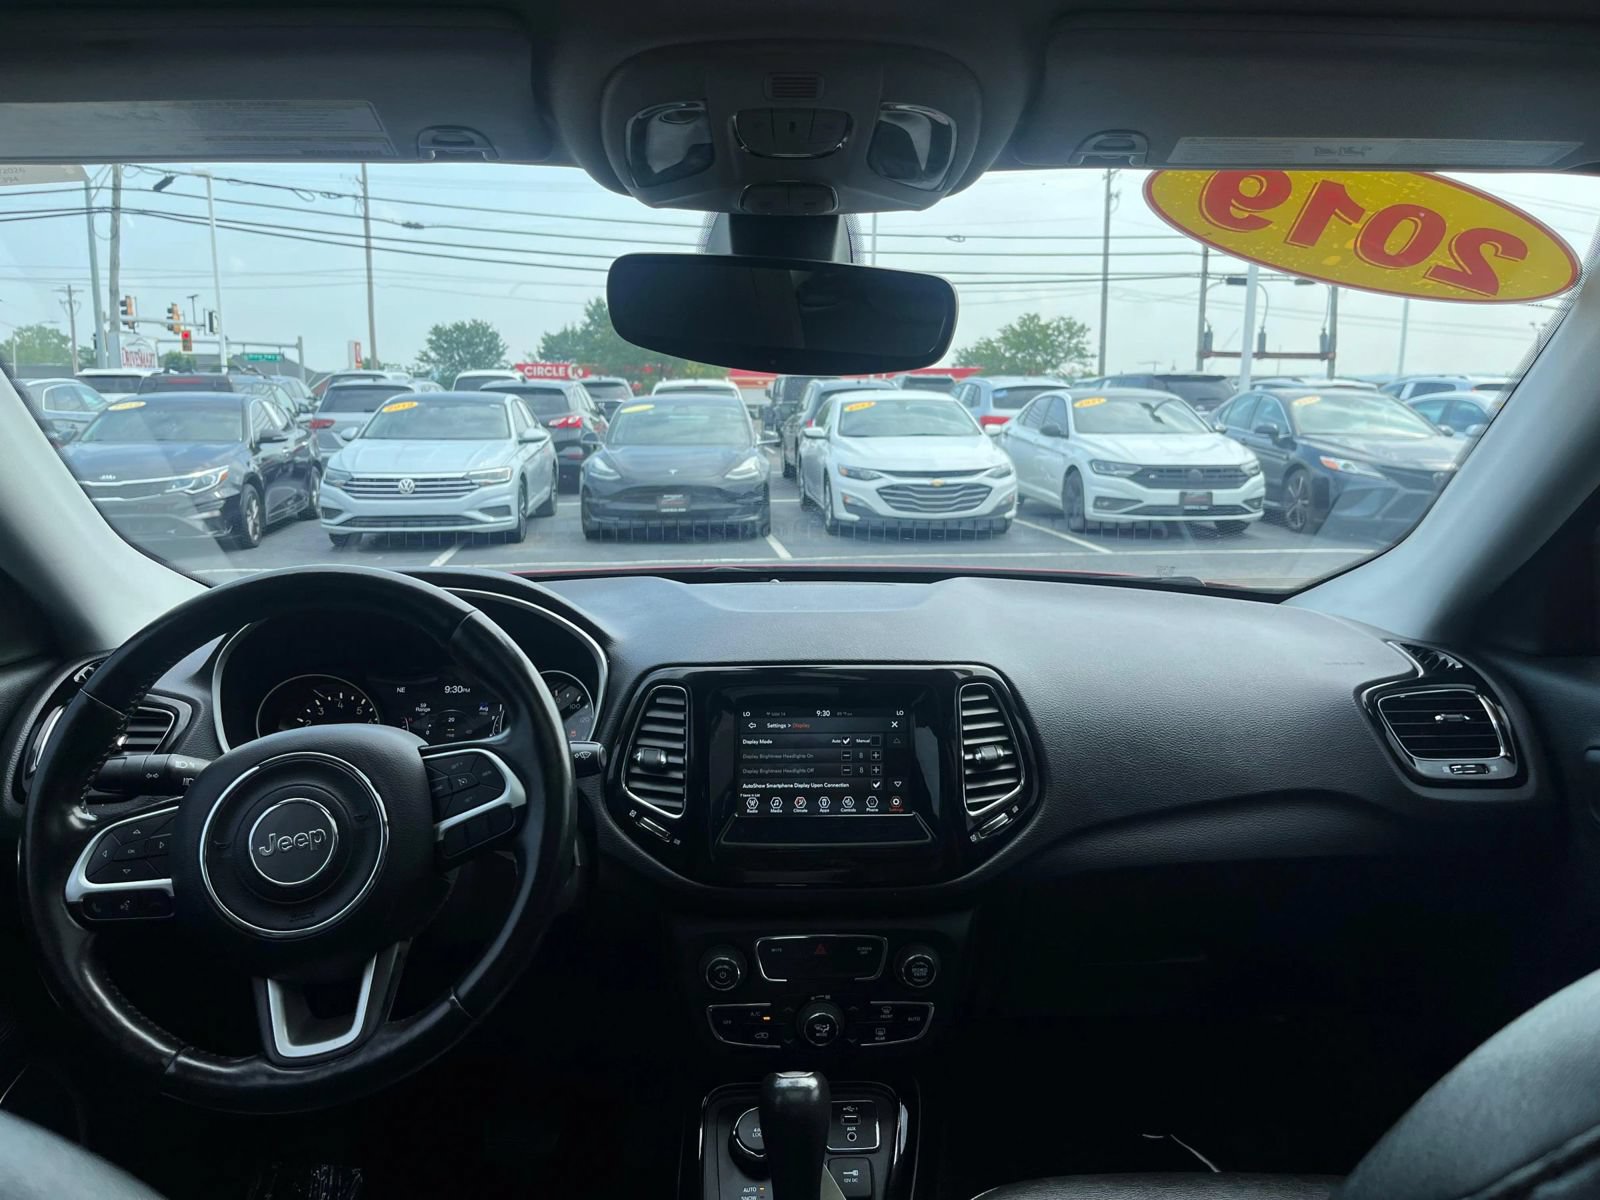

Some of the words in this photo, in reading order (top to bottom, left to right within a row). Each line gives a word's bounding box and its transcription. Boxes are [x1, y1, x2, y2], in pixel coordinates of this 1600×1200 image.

[524, 366, 566, 377] CIRCLE
[337, 701, 344, 709] 4
[569, 703, 581, 711] 100
[317, 707, 325, 716] 3
[356, 707, 363, 715] 5
[766, 782, 793, 790] Smartphone
[258, 828, 327, 857] Jeep
